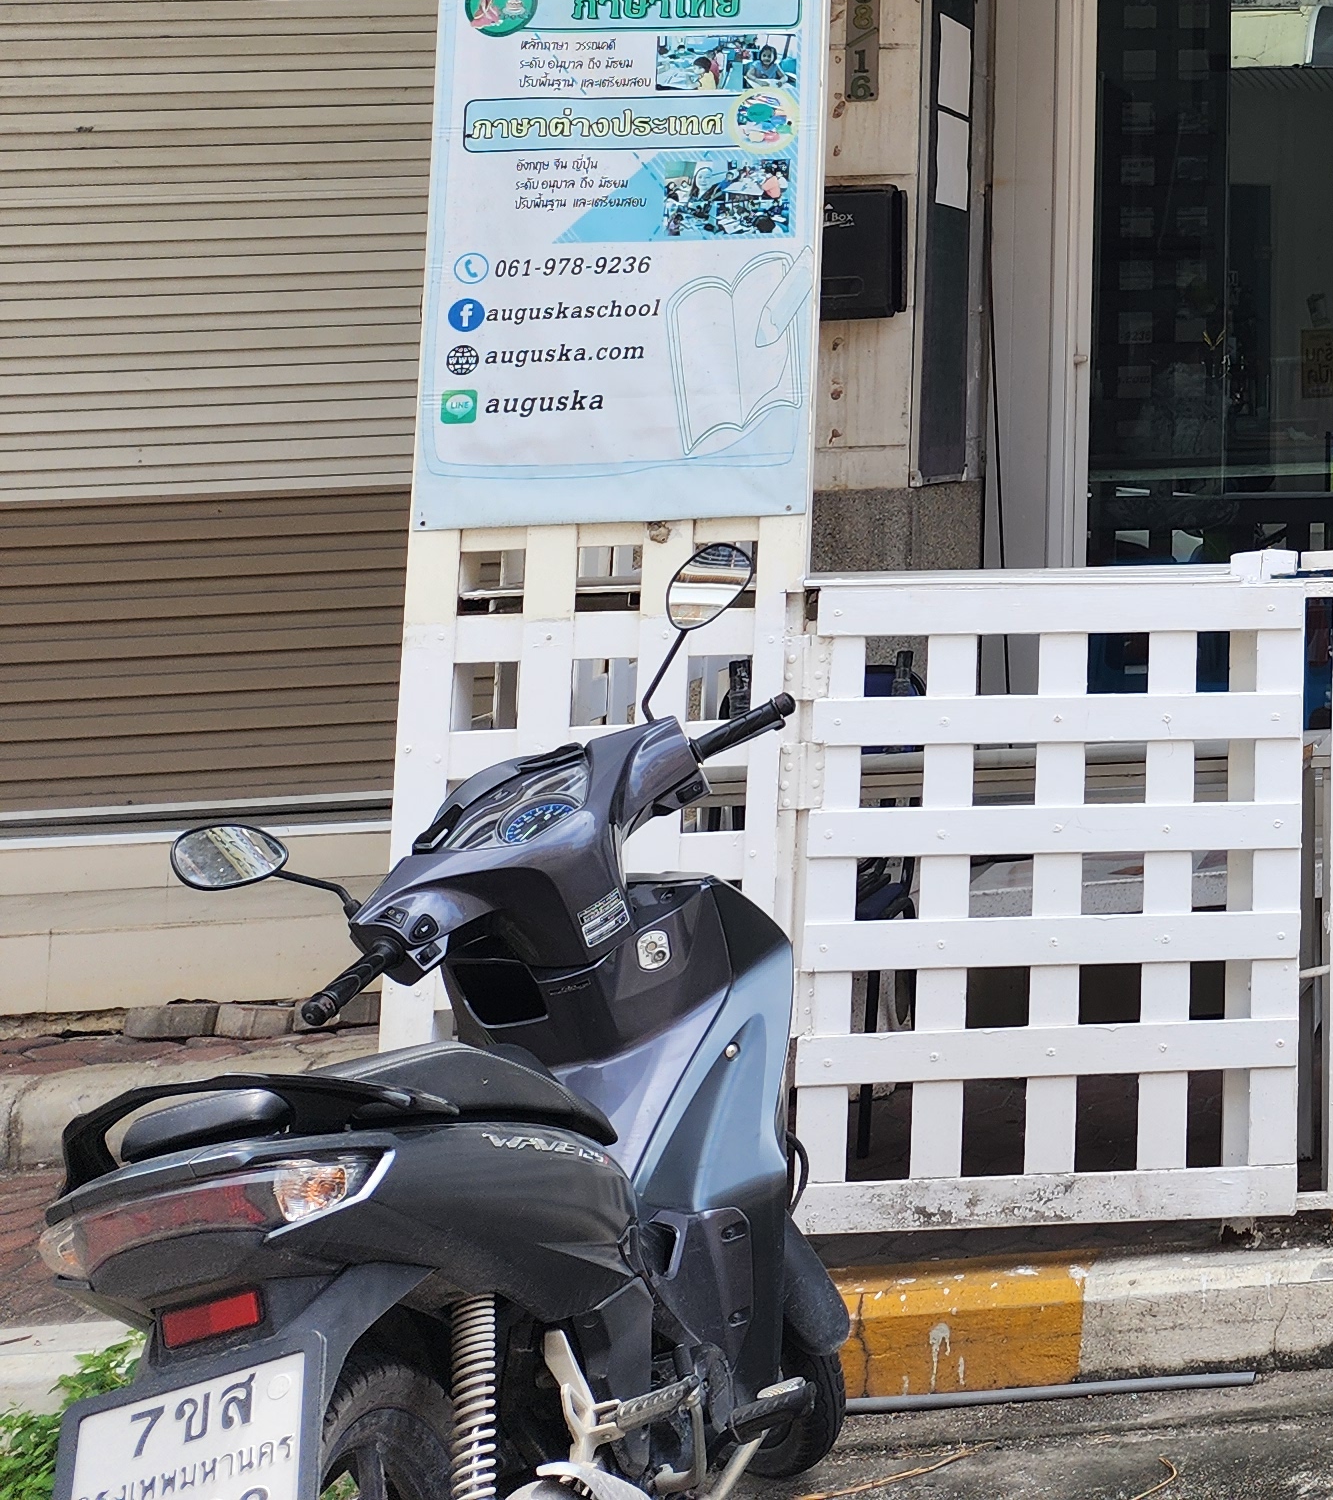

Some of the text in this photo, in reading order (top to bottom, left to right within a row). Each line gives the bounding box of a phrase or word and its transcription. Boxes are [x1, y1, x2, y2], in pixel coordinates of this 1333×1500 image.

[520, 37, 617, 52] หลักภาษา วรรณคดี
[547, 56, 584, 74] อนุบาล
[588, 56, 603, 70] ถึง
[605, 55, 634, 70] มัธยม
[518, 73, 652, 93] ปรับพื้นฐาน และเตรียมสอบ
[470, 108, 725, 140] ภาษาต่างประเทศ
[515, 157, 550, 175] อังกฤษ
[553, 157, 569, 172] จีน
[541, 177, 576, 194] อนุบาล
[579, 176, 595, 190] ถึง
[598, 176, 628, 190] มัธยม
[514, 193, 648, 213] ปรับพื้นฐาน และเตรียมสอบ
[831, 212, 853, 221] Box
[494, 256, 652, 279] 061-978-9236
[485, 299, 661, 326] auguskaschool
[484, 344, 645, 367] auguska.com
[450, 390, 605, 417] LINE auguska
